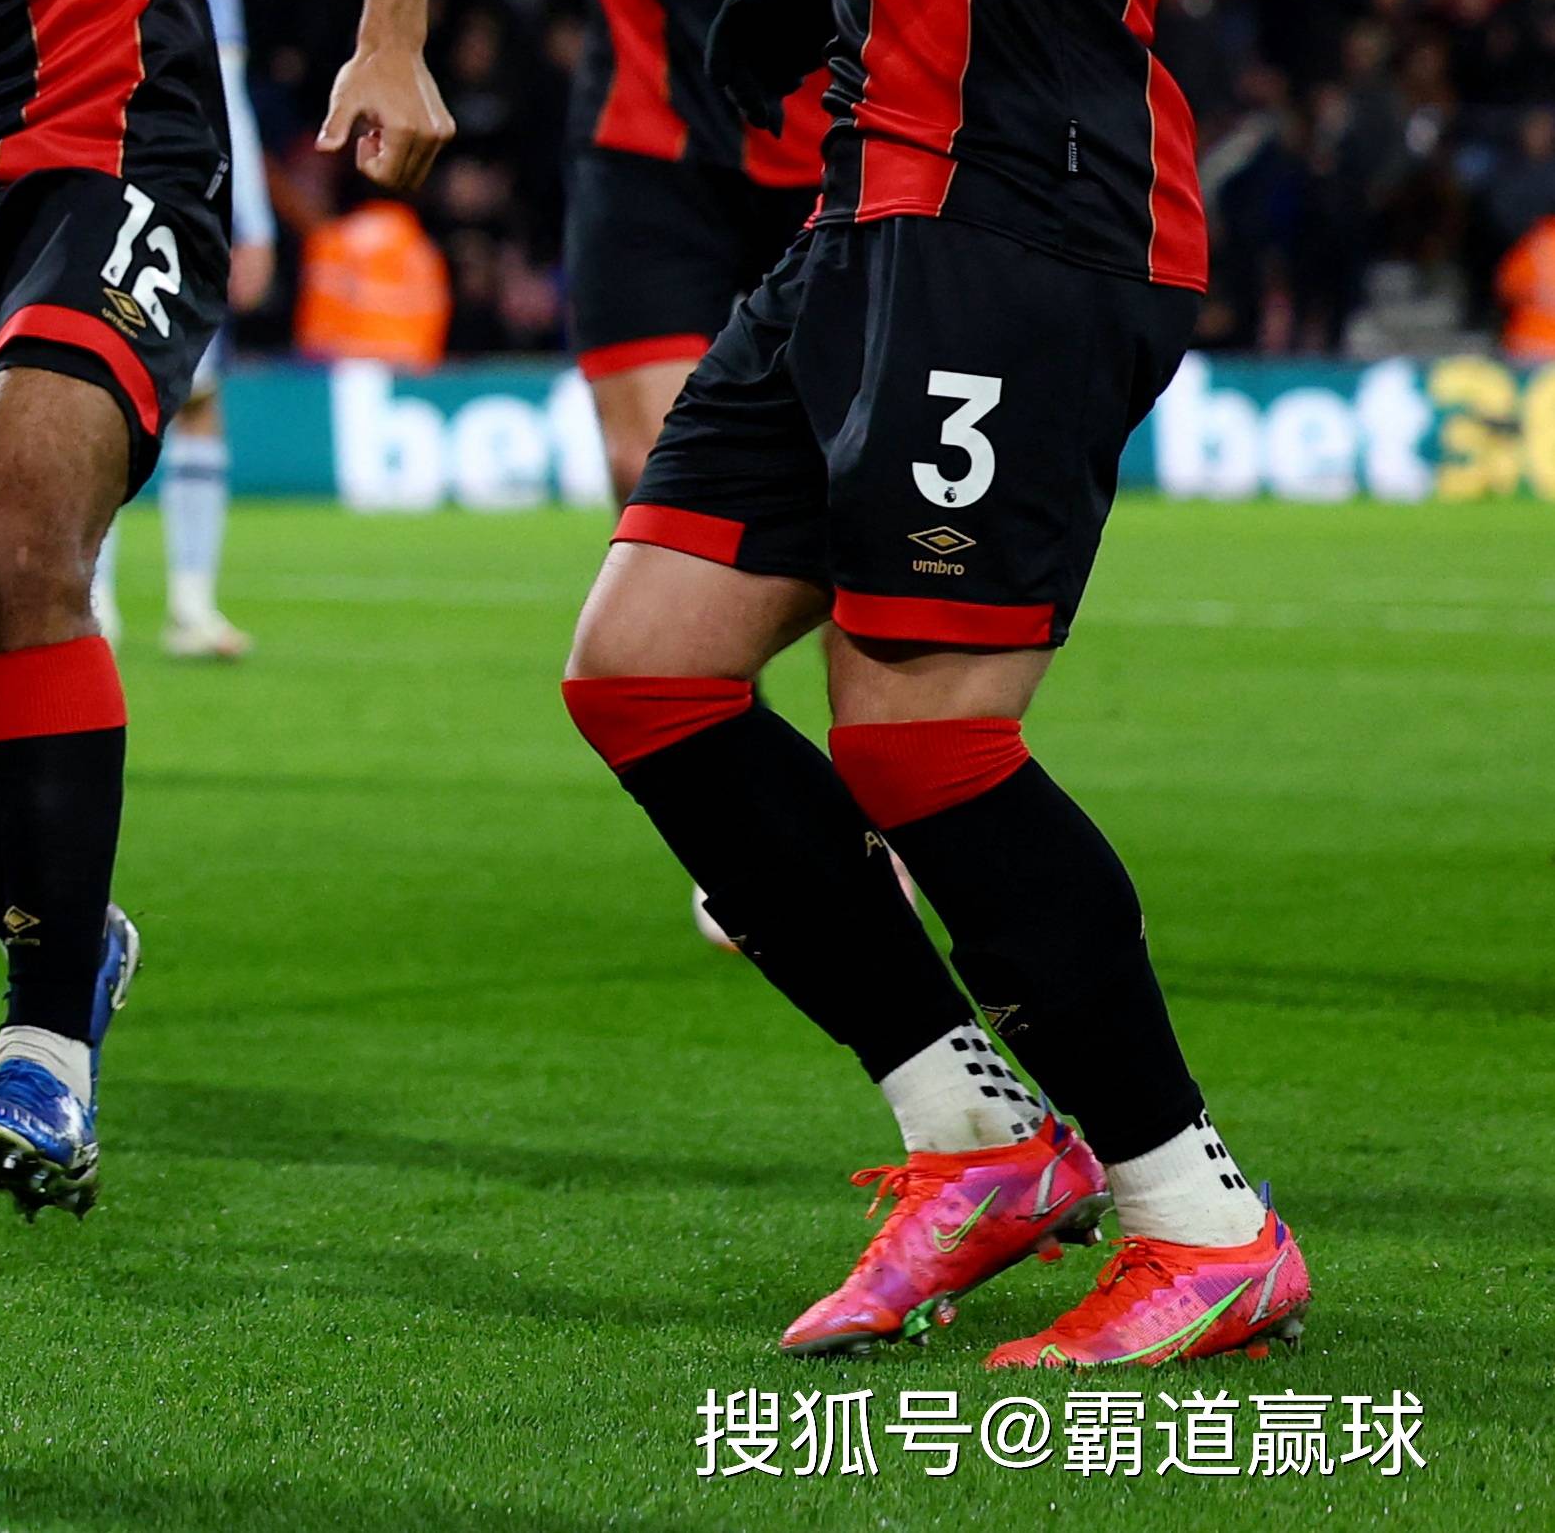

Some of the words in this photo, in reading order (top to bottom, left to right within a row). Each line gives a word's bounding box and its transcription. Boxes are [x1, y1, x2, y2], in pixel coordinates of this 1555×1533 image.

[100, 183, 182, 338] 12
[912, 370, 1002, 508] 3
[912, 559, 965, 576] umbro
